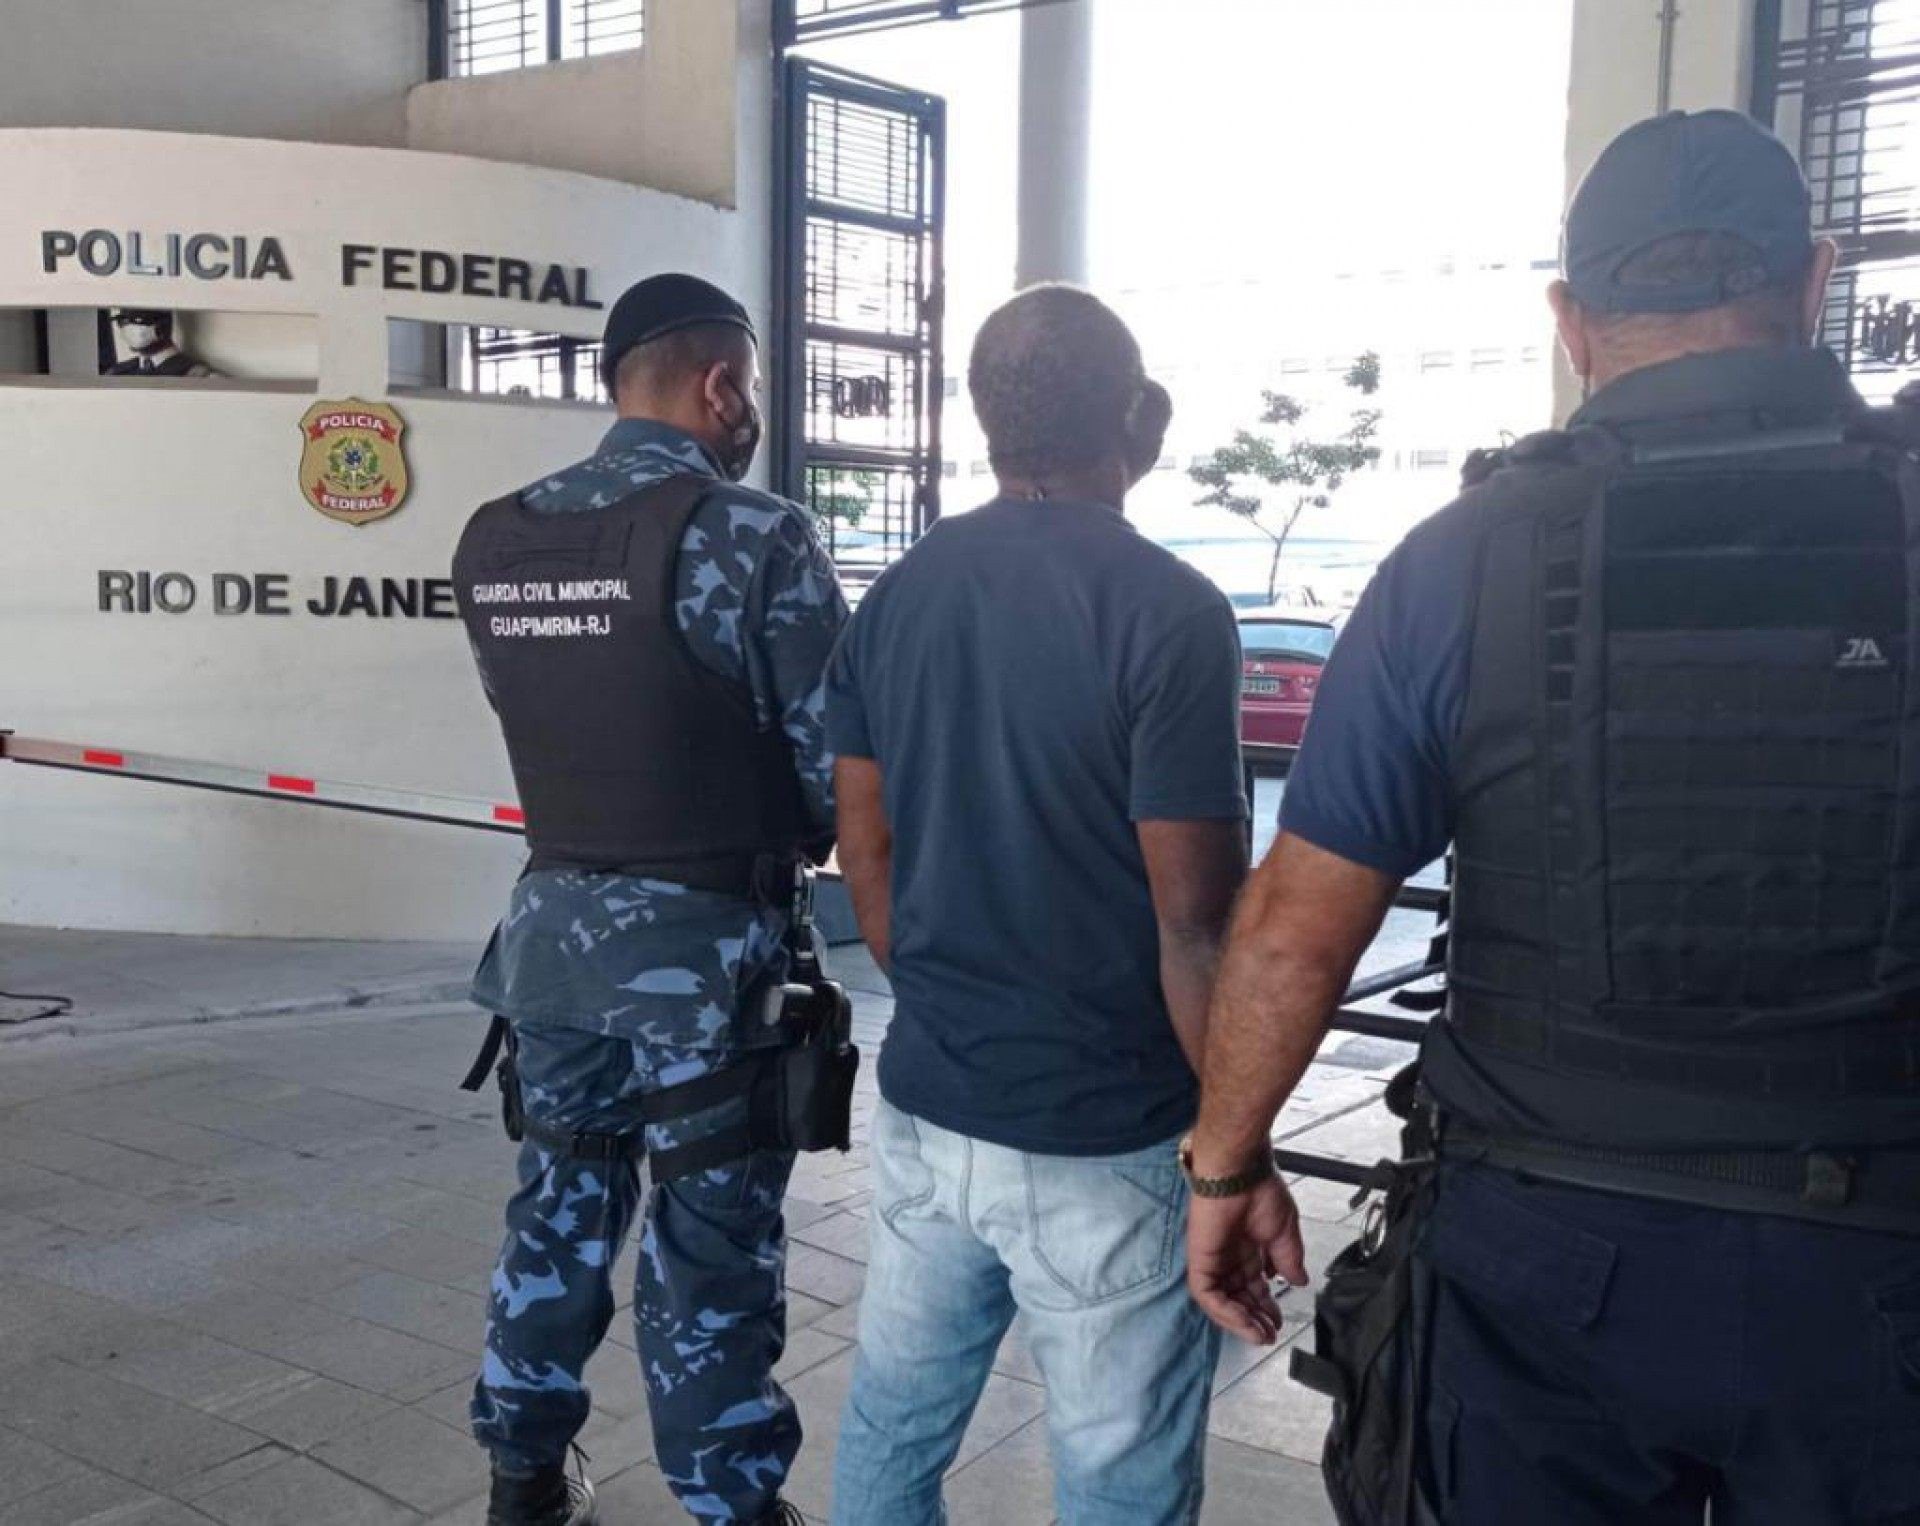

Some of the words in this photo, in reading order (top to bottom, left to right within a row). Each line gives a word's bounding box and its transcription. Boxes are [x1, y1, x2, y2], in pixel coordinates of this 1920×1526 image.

[41, 229, 293, 281] POLICIA
[341, 243, 604, 310] FEDERAL
[319, 413, 385, 431] POLICIA
[321, 494, 387, 511] FEDERAL
[98, 569, 196, 616] RIO
[212, 572, 291, 617] DE
[471, 583, 521, 604] GUARDA
[523, 582, 556, 602] CIVIL
[558, 578, 631, 601] MUNICIPAL
[490, 614, 611, 637] GUAPIMIRIM-RJ
